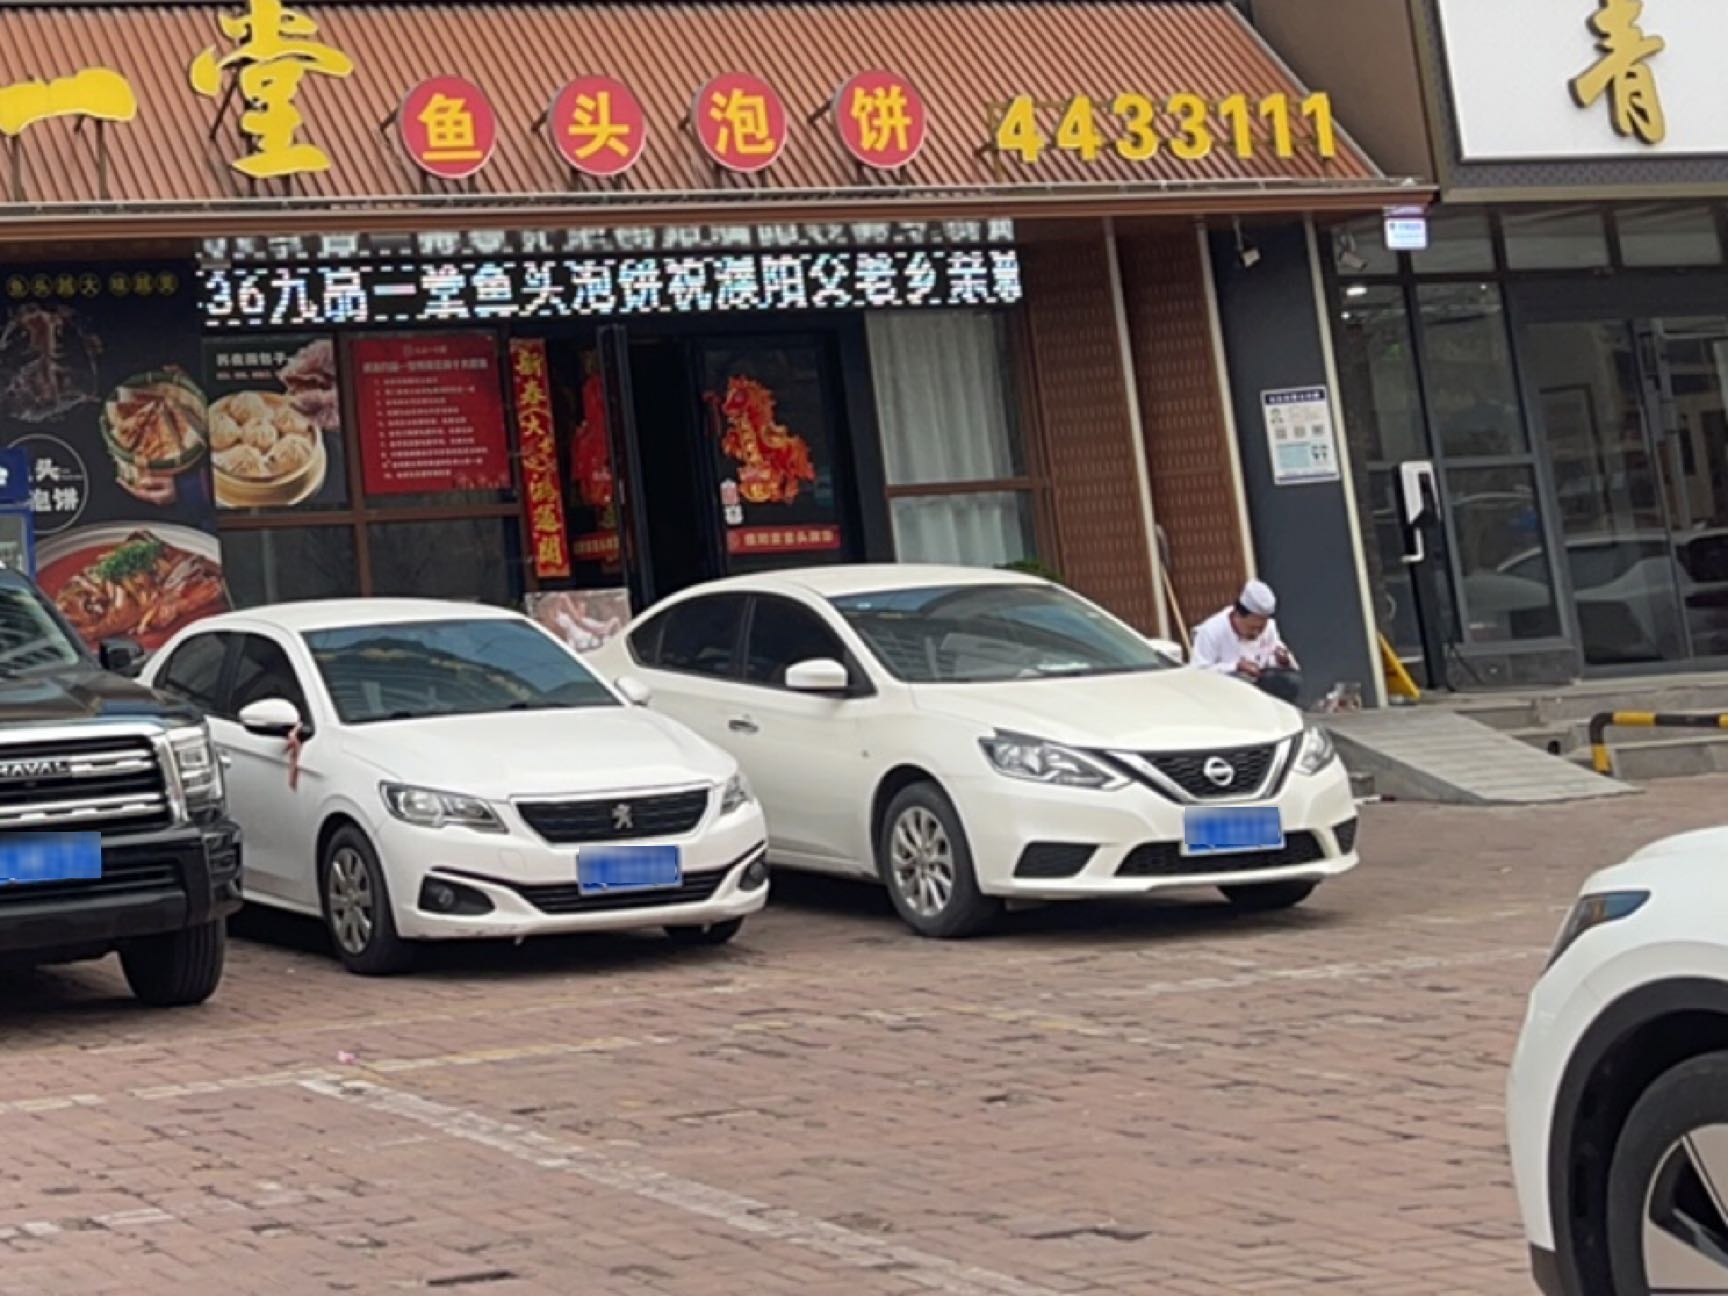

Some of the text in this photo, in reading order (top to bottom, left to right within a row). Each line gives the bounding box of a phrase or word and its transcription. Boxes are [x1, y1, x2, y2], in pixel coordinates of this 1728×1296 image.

[418, 85, 913, 161] 鱼头泡饼
[997, 91, 1338, 162] 4433111
